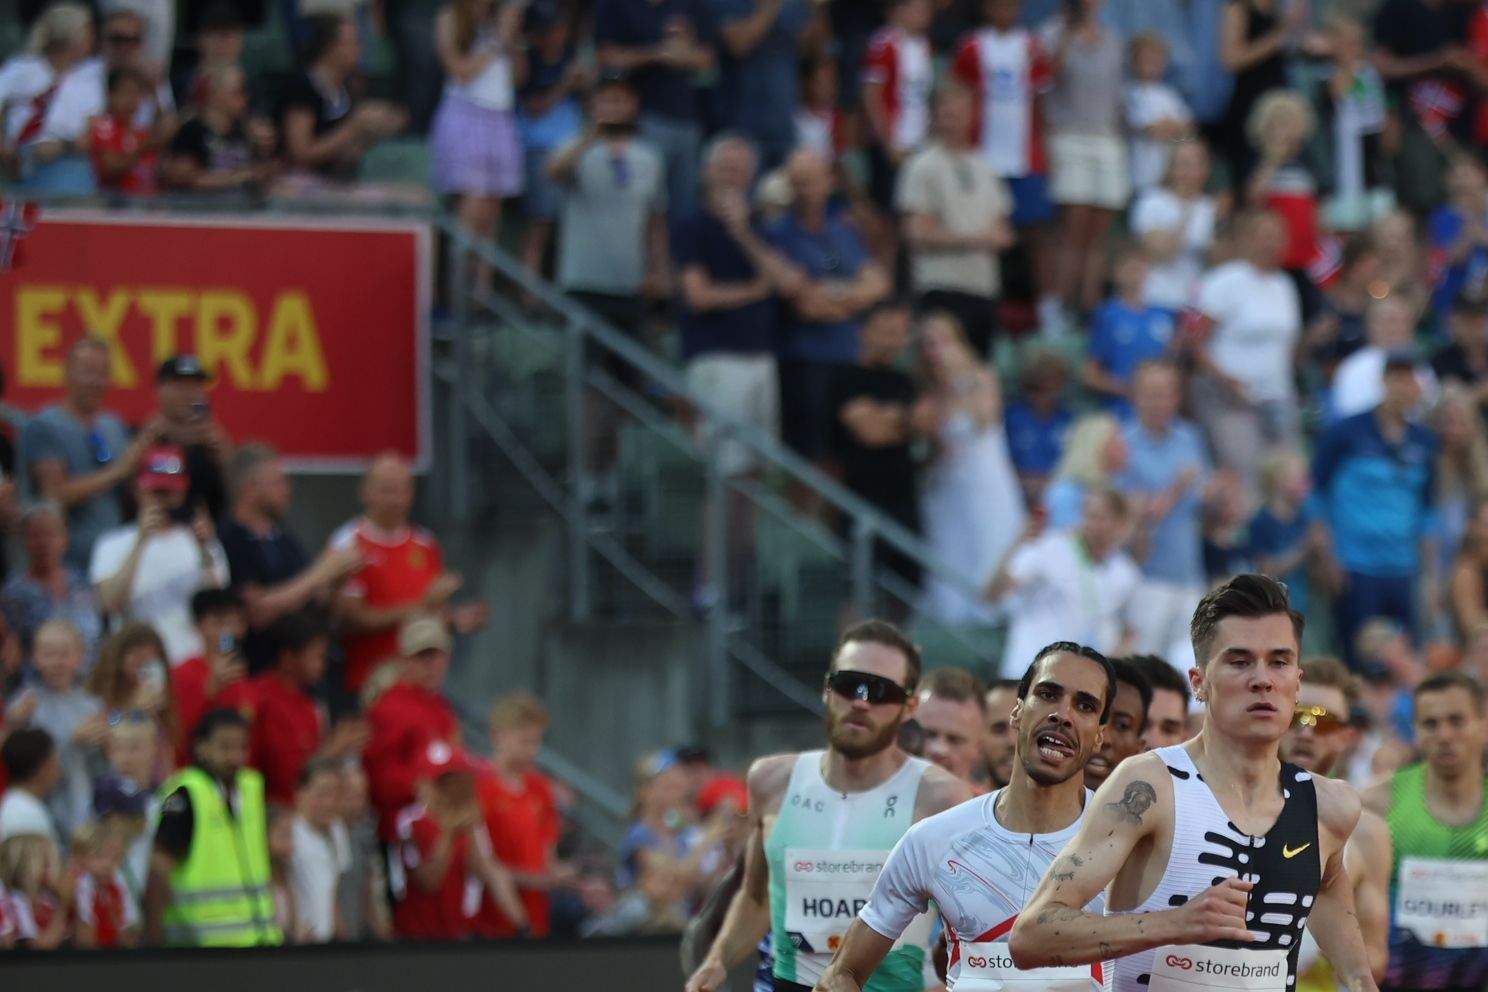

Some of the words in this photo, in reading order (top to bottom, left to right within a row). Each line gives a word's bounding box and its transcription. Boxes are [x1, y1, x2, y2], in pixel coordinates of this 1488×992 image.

[15, 287, 330, 390] EXTRA
[817, 861, 884, 873] storebran
[1195, 959, 1280, 977] storebrand
